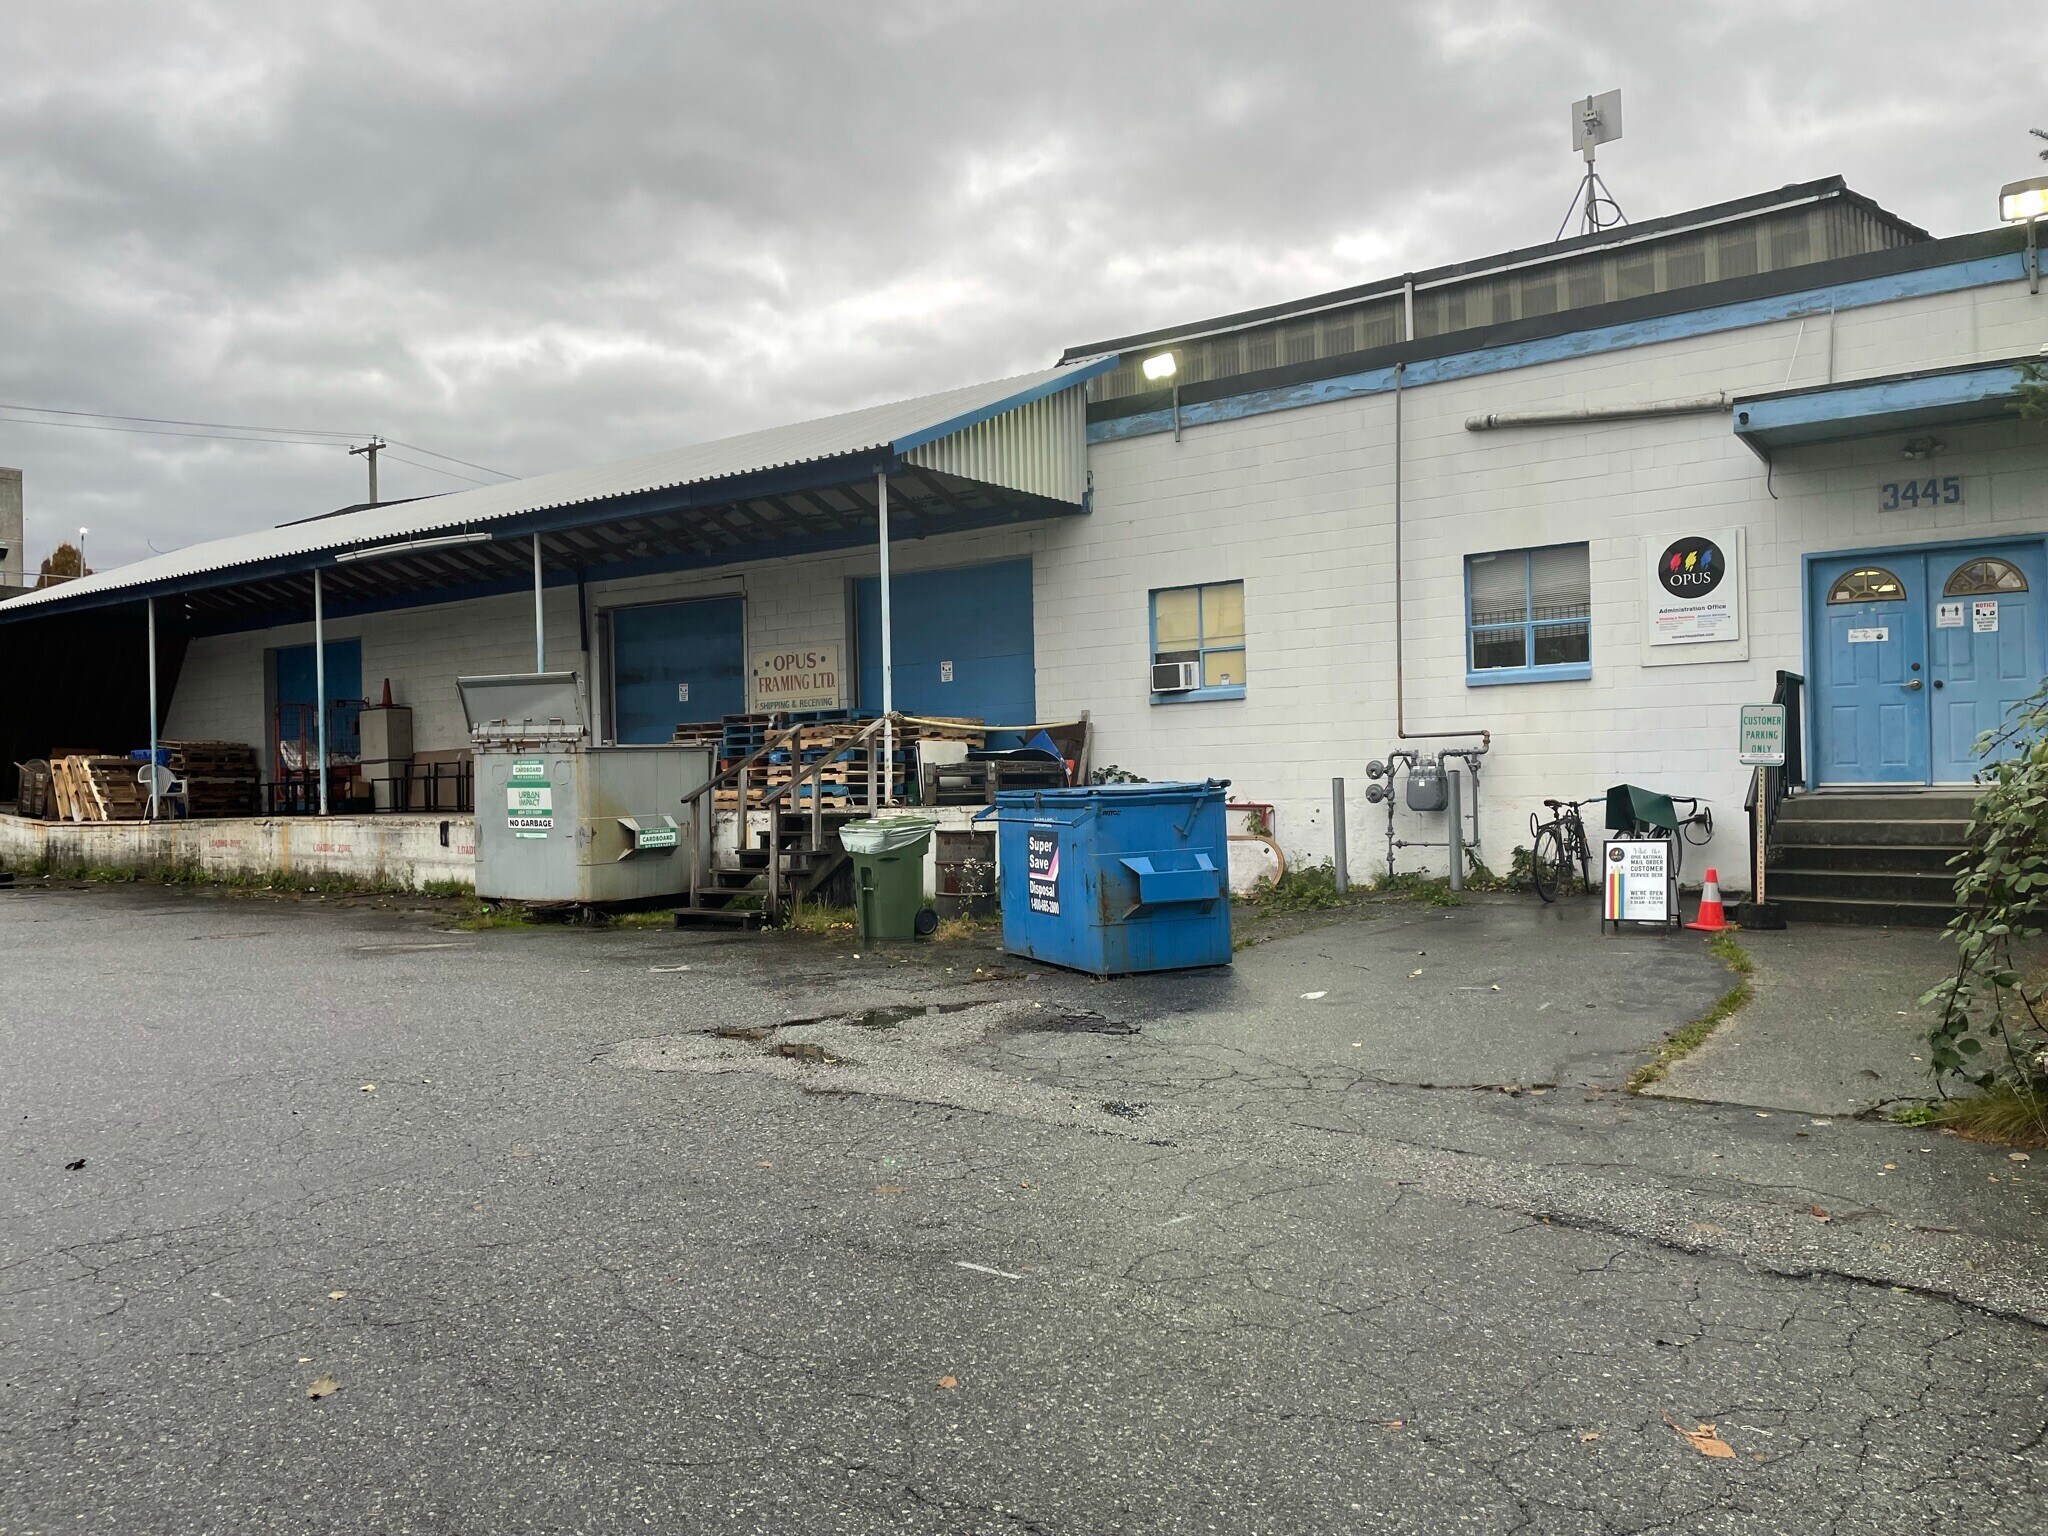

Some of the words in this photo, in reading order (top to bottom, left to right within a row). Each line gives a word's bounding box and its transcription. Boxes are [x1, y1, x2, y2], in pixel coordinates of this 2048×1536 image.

[1882, 477, 1960, 510] 3445
[1670, 571, 1711, 587] OPUS
[1659, 606, 1706, 614] Administration
[1707, 603, 1727, 611] Office
[773, 652, 817, 671] OPUS
[759, 674, 809, 693] FRAMING
[813, 672, 836, 689] LTD.
[760, 700, 790, 710] SHIPPING
[792, 700, 798, 708] &
[800, 698, 833, 708] RECEIVING
[1743, 716, 1782, 725] CUSTOMER
[1745, 730, 1779, 739] PARKING
[1751, 744, 1772, 753] ONLY
[518, 790, 540, 799] URBAN
[519, 799, 540, 807] IMPACT
[509, 819, 519, 827] NO
[521, 819, 552, 828] GARBAGE
[642, 834, 674, 843] CARDBOARD
[1029, 836, 1053, 854] Super
[1029, 854, 1049, 870] Save
[1029, 880, 1055, 898] Disposal
